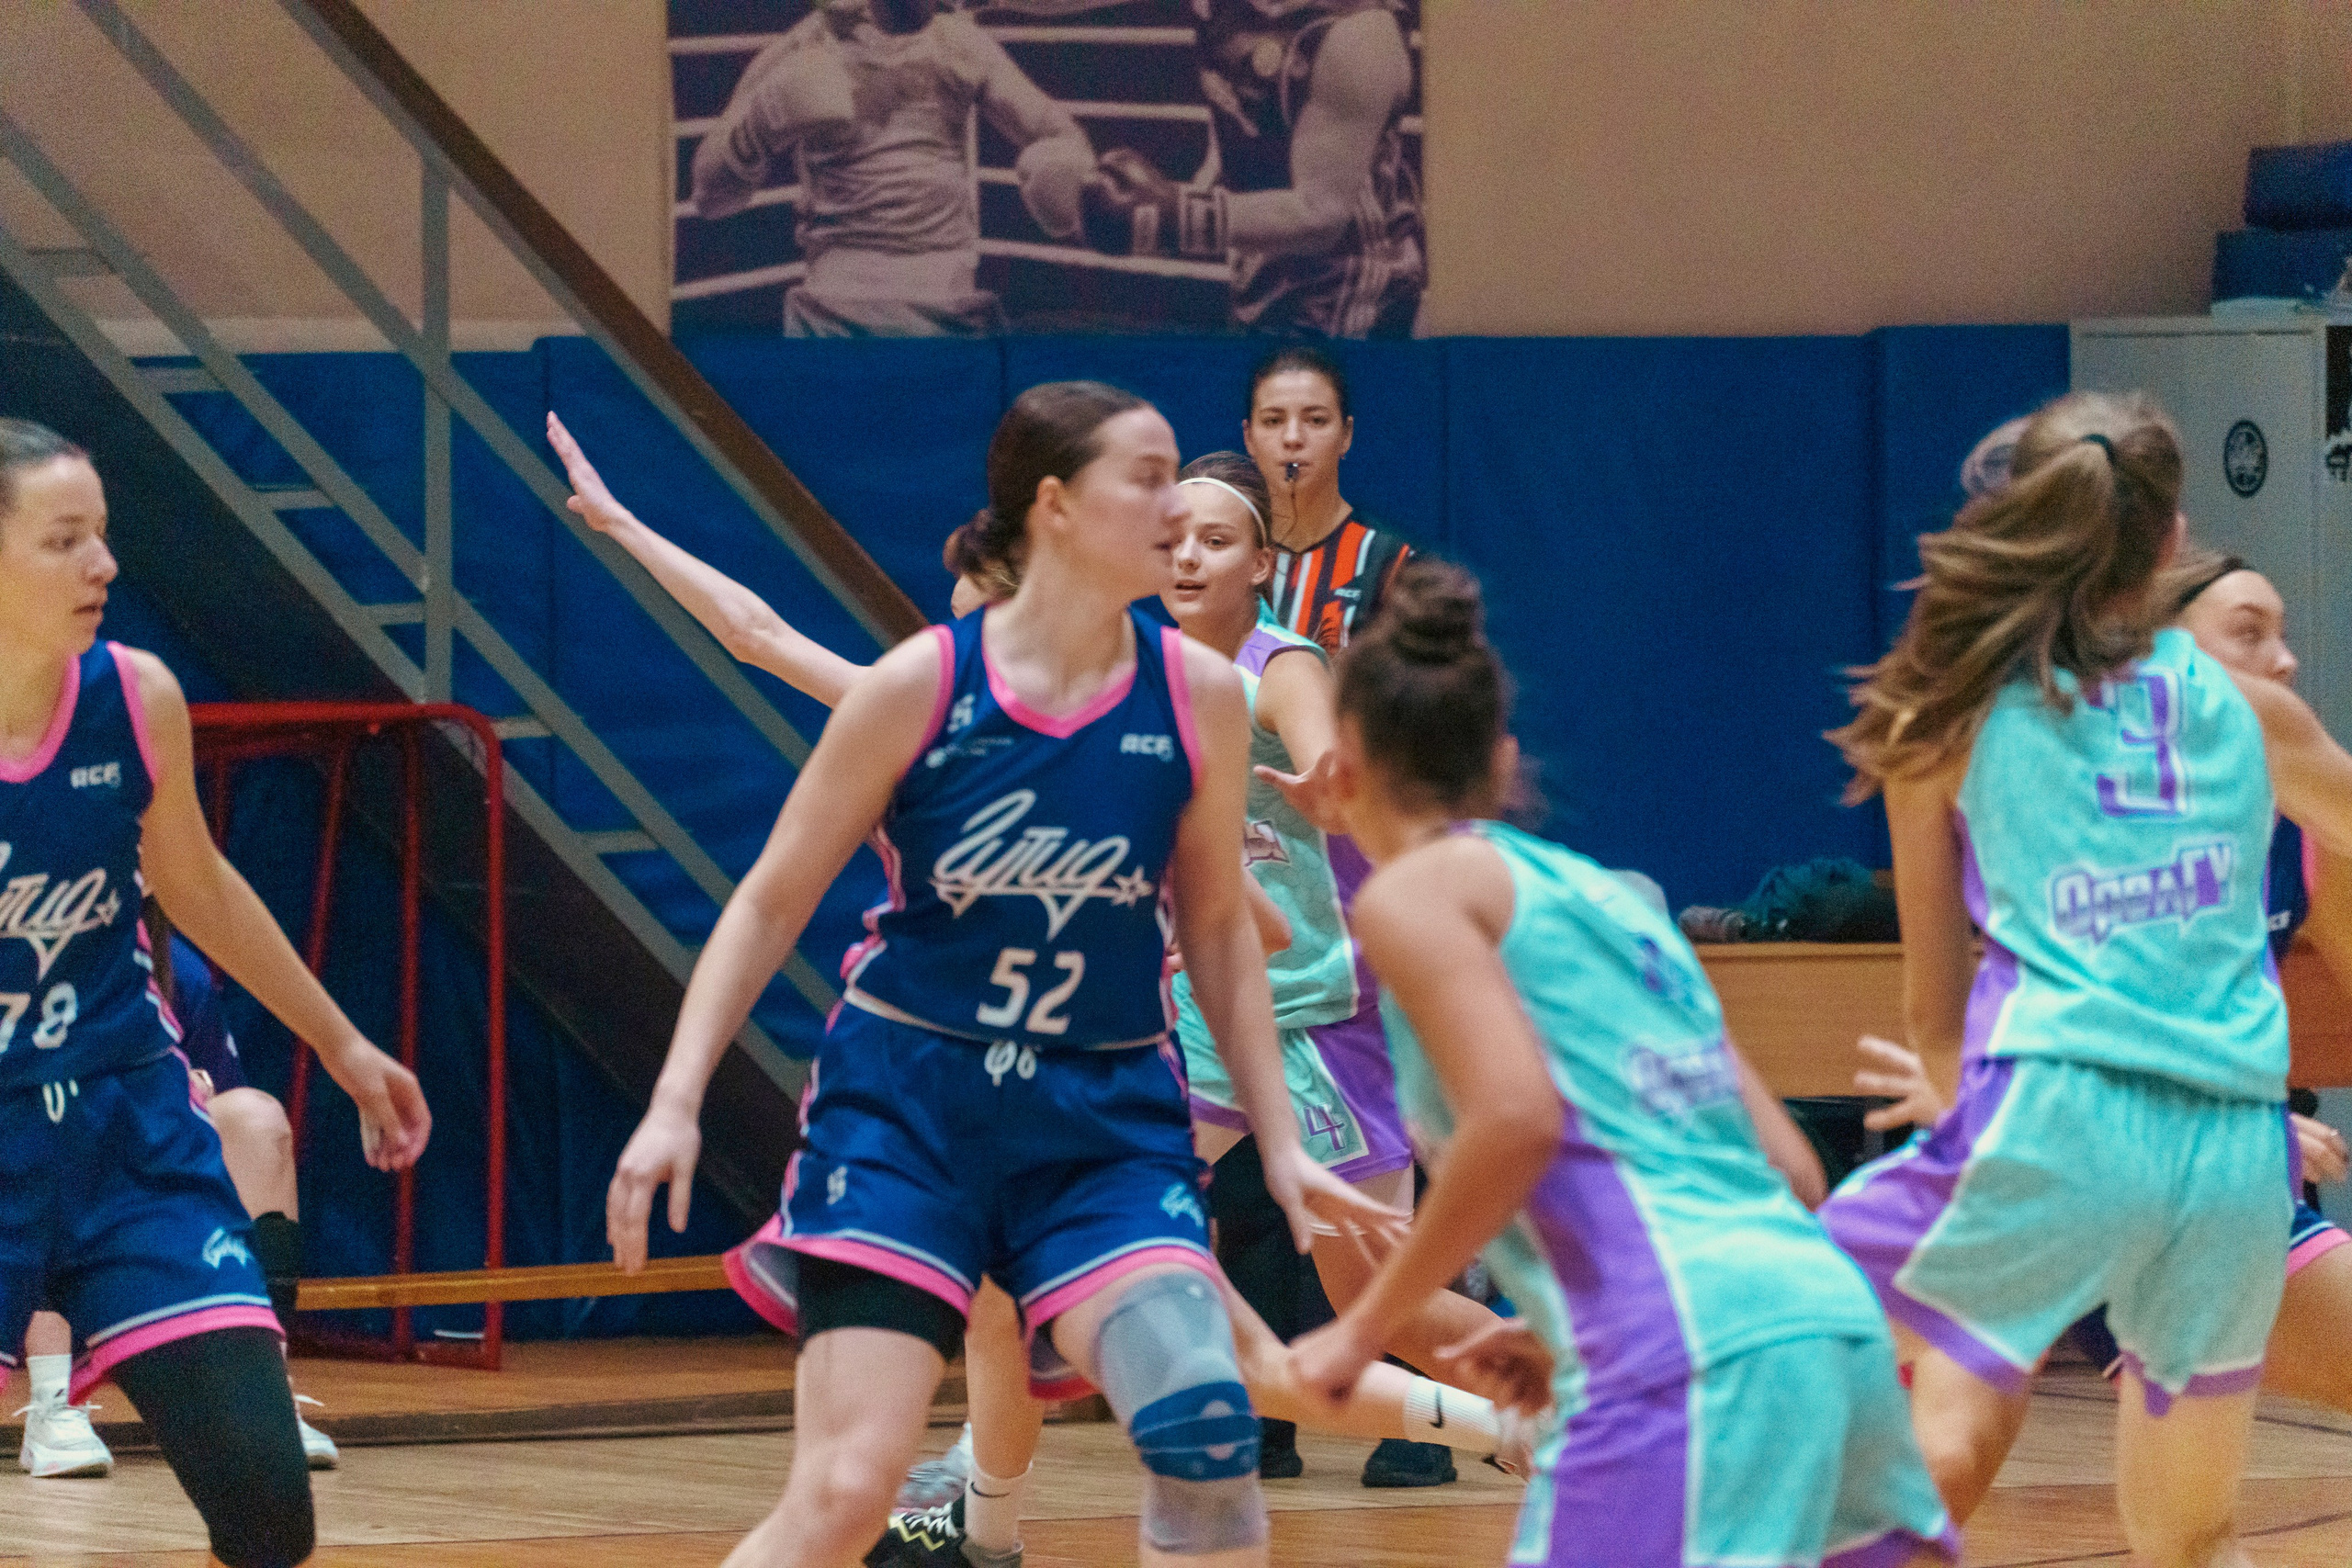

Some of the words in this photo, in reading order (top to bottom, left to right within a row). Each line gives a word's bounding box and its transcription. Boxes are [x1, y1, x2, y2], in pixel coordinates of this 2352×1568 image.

[2087, 665, 2188, 817] 3
[0, 982, 78, 1053] 78
[976, 947, 1086, 1034] 52
[1303, 1103, 1346, 1152] 4
